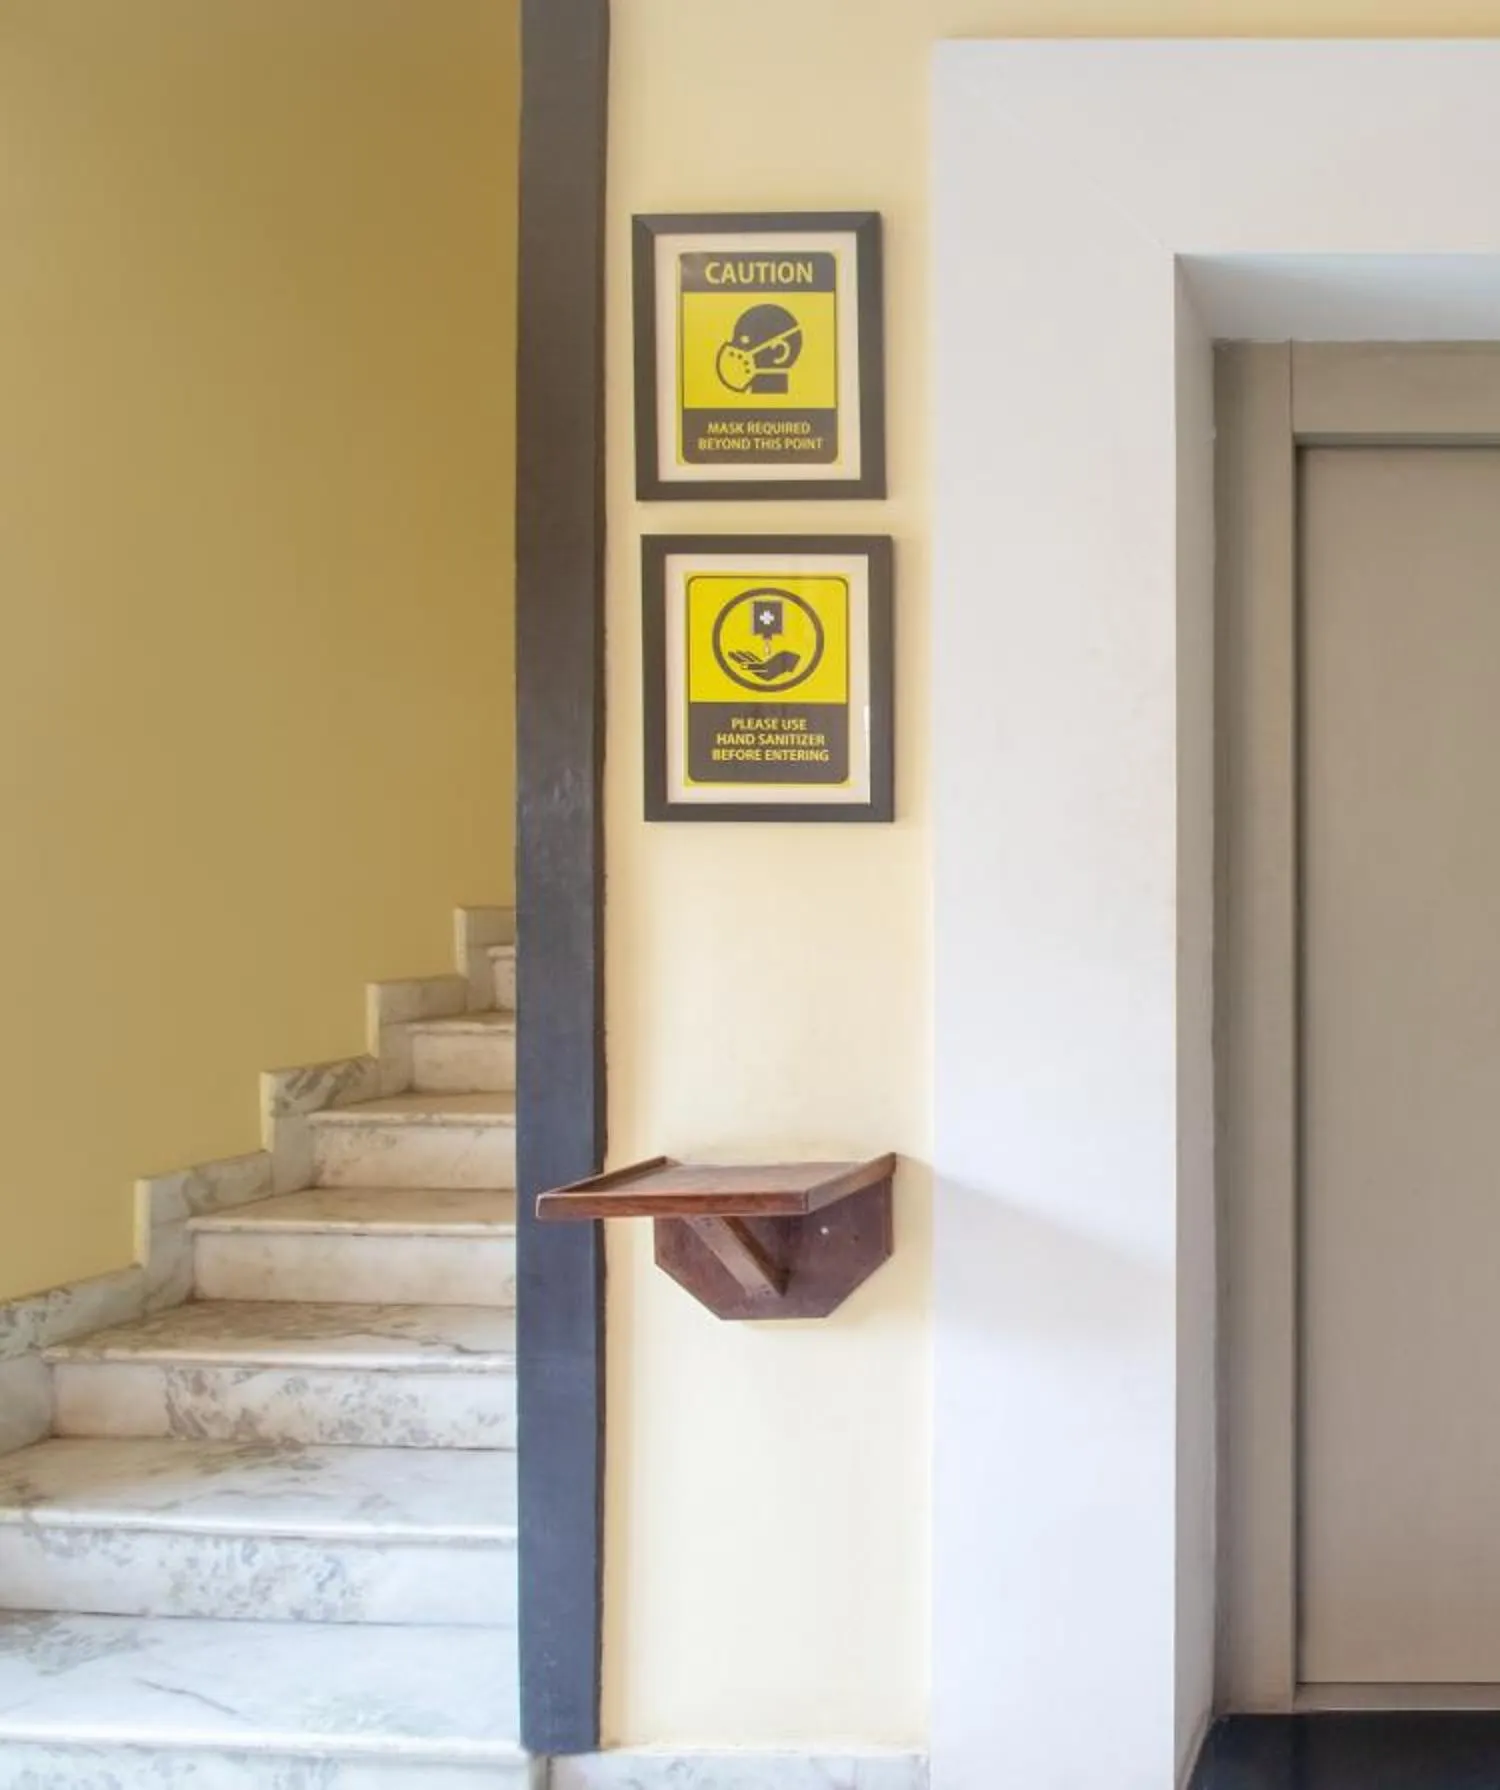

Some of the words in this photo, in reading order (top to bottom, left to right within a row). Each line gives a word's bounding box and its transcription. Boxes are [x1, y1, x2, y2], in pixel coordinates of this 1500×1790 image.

[705, 261, 814, 285] CAUTION
[707, 421, 744, 434] MASK
[747, 421, 811, 436] REQUIRED
[698, 437, 751, 450] BEYOND
[754, 437, 782, 449] THIS
[785, 437, 823, 449] POINT
[731, 718, 778, 730] PLEASE
[781, 718, 807, 730] USE
[717, 734, 755, 745] HAND
[758, 734, 825, 746] SANITIZER
[712, 750, 762, 761] BEFORE
[765, 750, 829, 761] ENTERING
